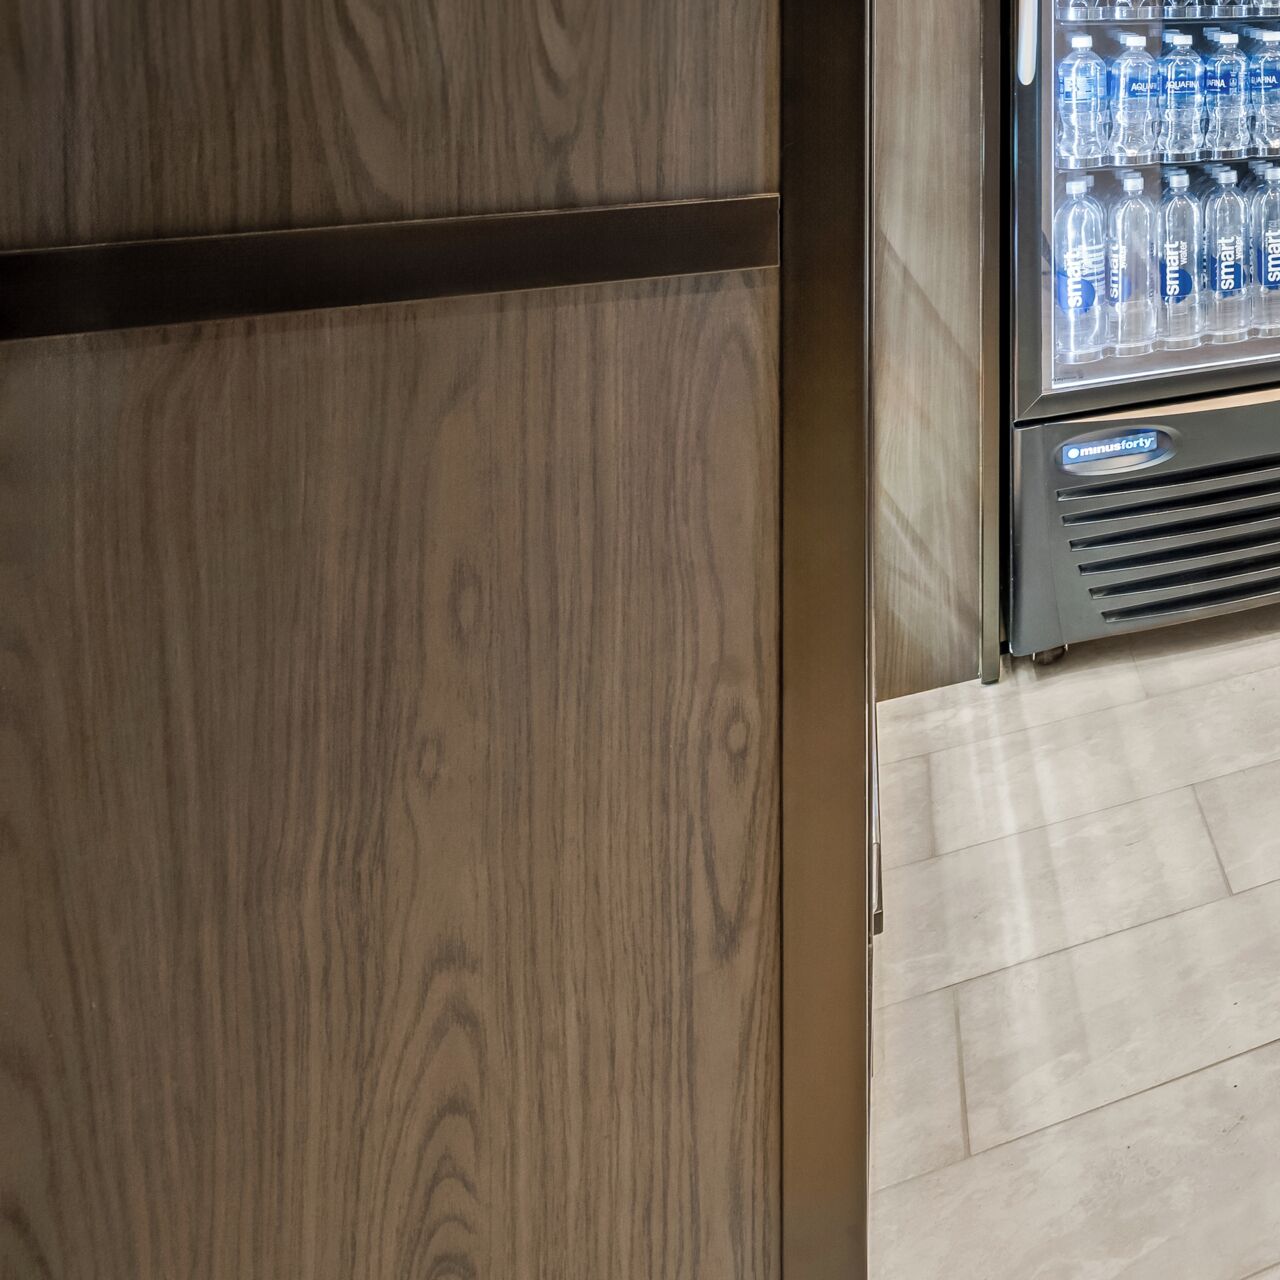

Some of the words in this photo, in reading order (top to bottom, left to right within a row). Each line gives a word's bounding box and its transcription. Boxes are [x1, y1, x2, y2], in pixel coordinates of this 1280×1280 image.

[1165, 240, 1180, 296] smart
[1217, 236, 1235, 291] smart
[1265, 229, 1280, 282] smart
[1080, 436, 1154, 457] minusforty
